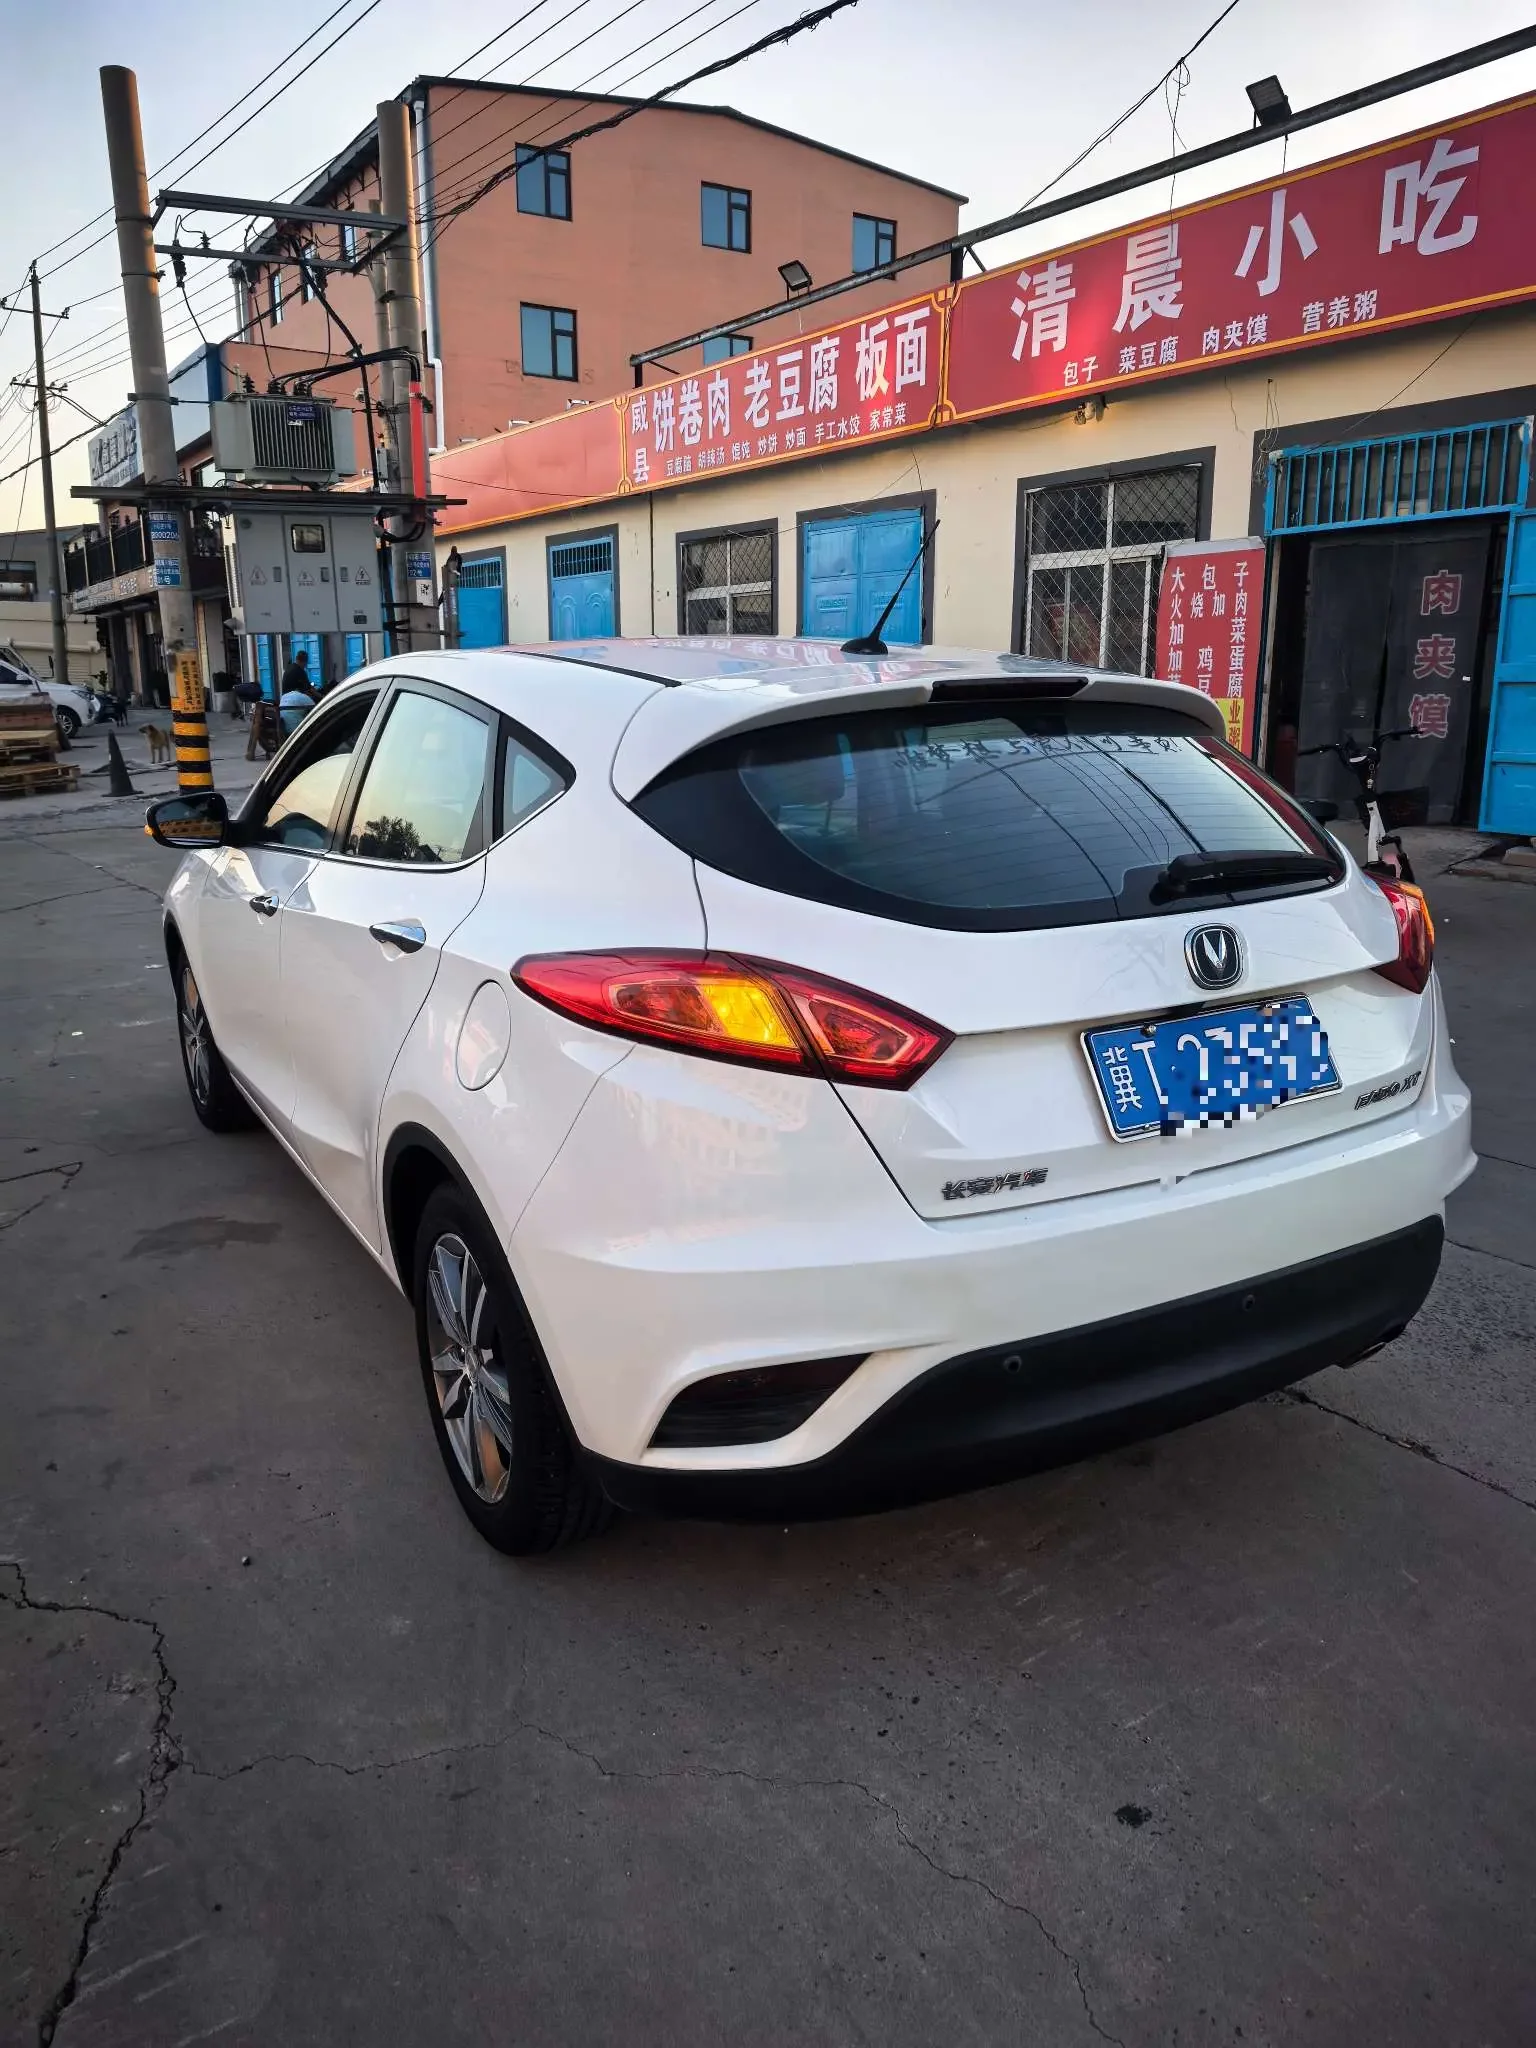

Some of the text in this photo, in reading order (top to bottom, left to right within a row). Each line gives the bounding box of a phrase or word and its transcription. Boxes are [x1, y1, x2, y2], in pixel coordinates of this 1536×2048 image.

[1010, 139, 1480, 362] 清晨小吃
[653, 306, 931, 453] 饼卷肉 老豆腐 板面
[1063, 288, 1379, 387] 包子 菜豆腐 肉夹馍 营养粥
[631, 394, 650, 484] 威县
[758, 432, 778, 456] 炒饼
[785, 426, 807, 450] 炒面
[815, 413, 862, 444] 手工水饺
[869, 401, 907, 431] 家常菜
[1408, 569, 1463, 740] 肉夹馍
[941, 1168, 1049, 1200] 长安汽车
